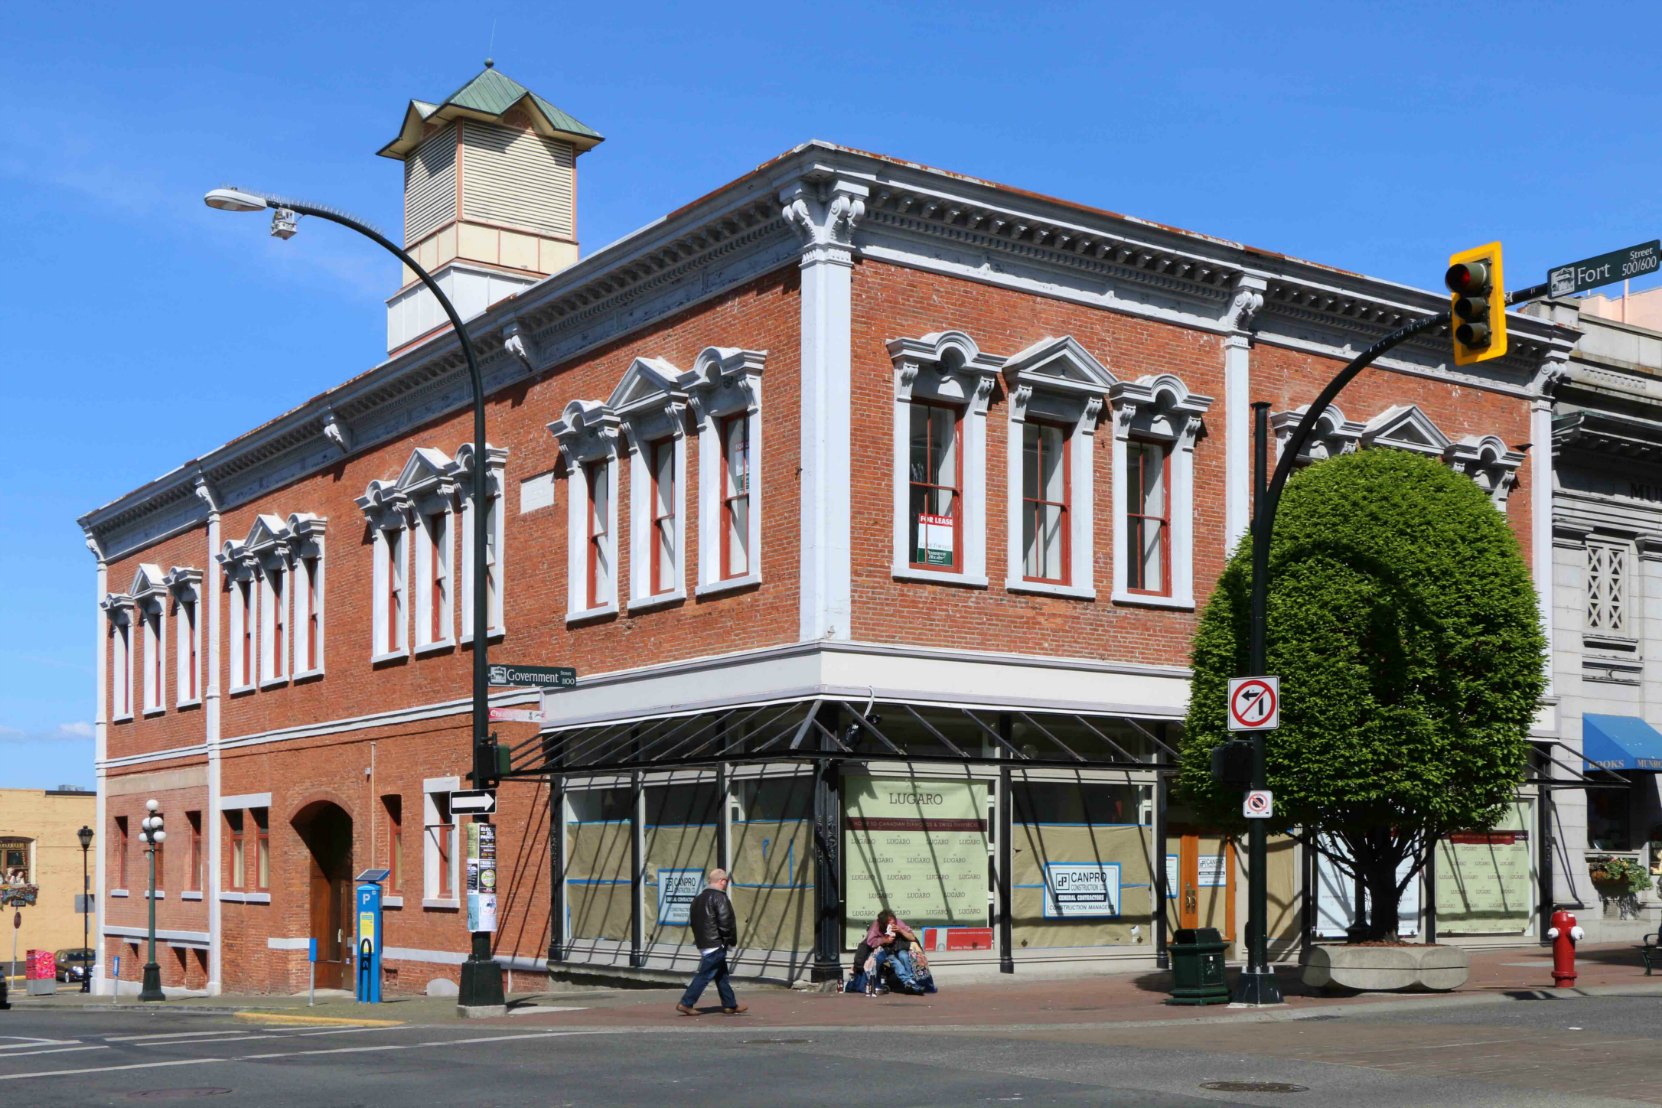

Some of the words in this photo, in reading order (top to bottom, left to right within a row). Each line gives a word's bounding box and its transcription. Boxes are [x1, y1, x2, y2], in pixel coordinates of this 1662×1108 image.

[1630, 246, 1653, 260] Street
[1577, 263, 1611, 285] Fort
[1621, 256, 1657, 276] 500/600
[934, 516, 952, 526] LEASE
[506, 669, 559, 683] Government
[1588, 760, 1624, 768] BOOKS
[889, 792, 943, 805] LUGARO
[674, 878, 696, 886] CANPRO
[1071, 872, 1107, 882] CANPRO
[363, 894, 370, 904] P
